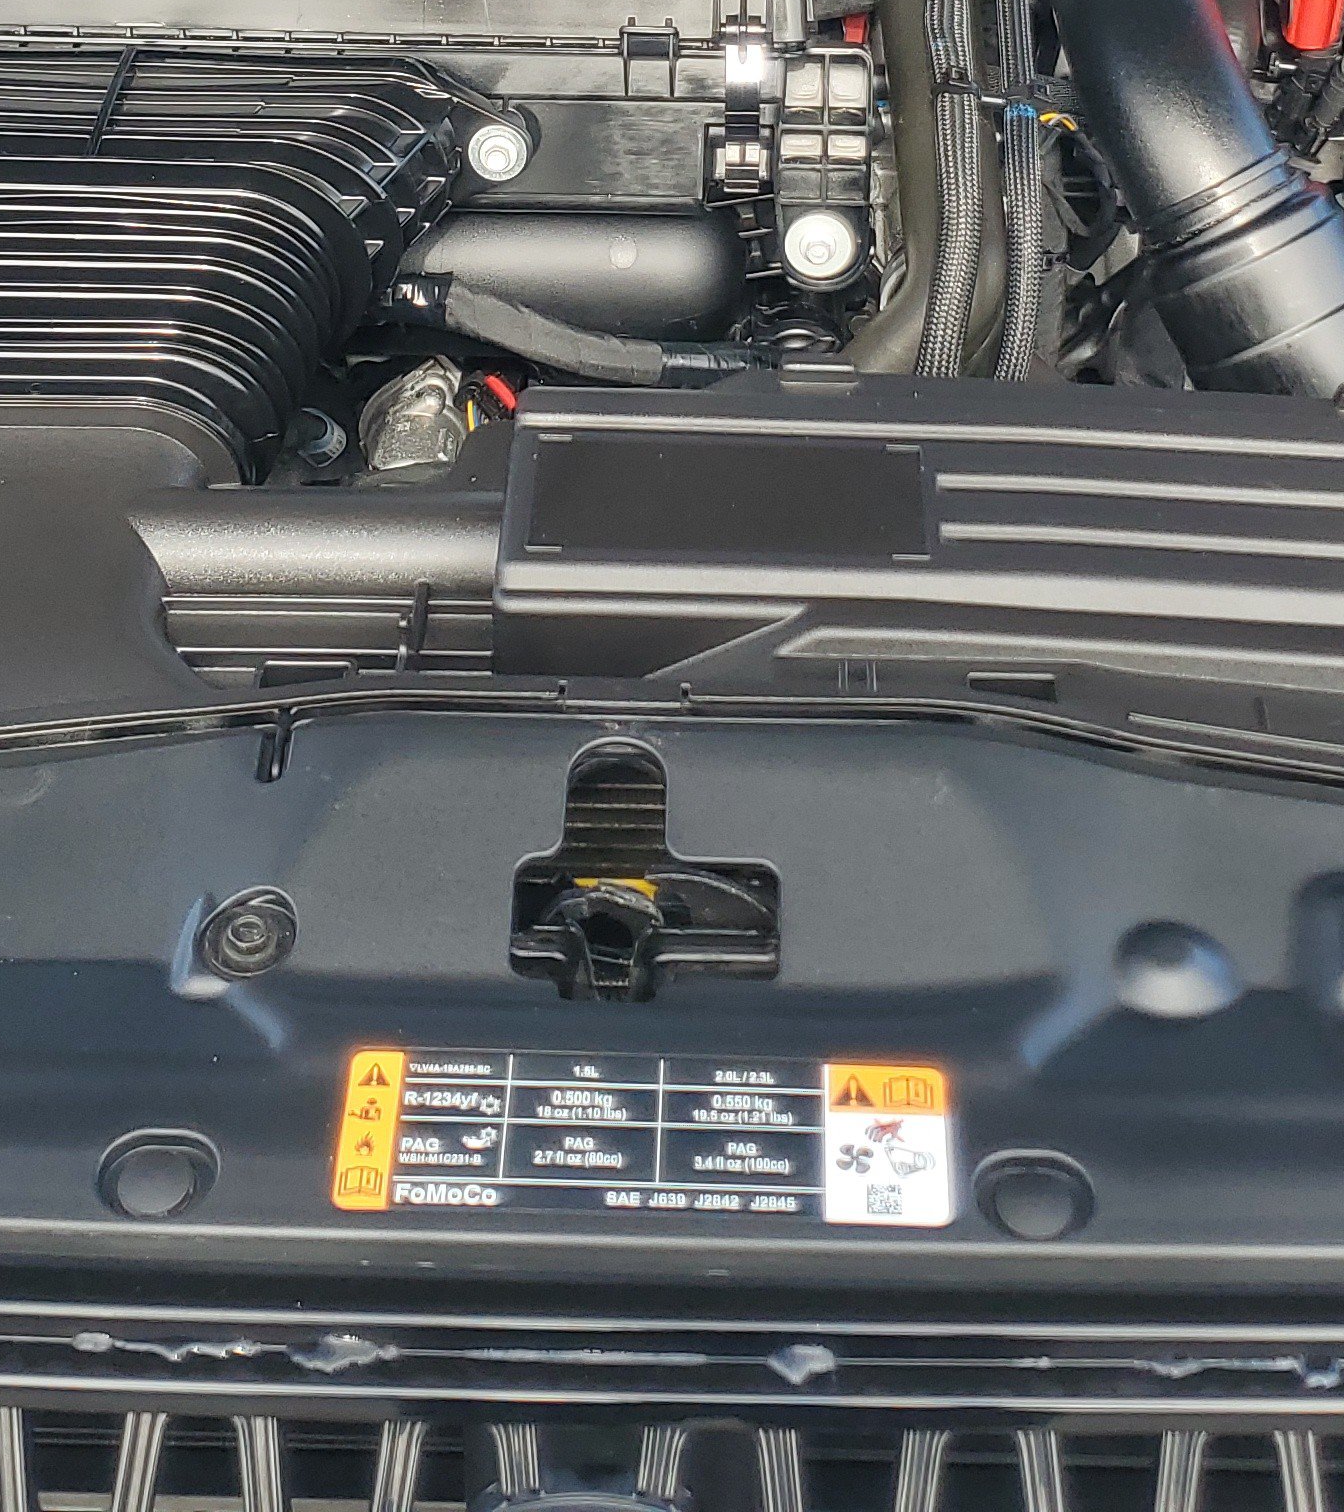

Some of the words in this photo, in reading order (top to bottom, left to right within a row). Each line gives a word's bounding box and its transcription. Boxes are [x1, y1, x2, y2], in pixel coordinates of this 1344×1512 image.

[573, 1066, 600, 1078] 1.5L
[715, 1071, 741, 1083] 2.0L
[404, 1091, 479, 1110] R-1234yf
[552, 1090, 591, 1104] 0.500
[594, 1091, 613, 1107] kg
[713, 1095, 751, 1109] 0.550
[754, 1096, 773, 1113] kg
[537, 1105, 552, 1117] 18
[554, 1108, 570, 1118] oz
[572, 1106, 600, 1120] (1.10
[603, 1108, 627, 1121] lbs)
[720, 1112, 736, 1122] oz
[738, 1111, 766, 1124] (1.21
[770, 1111, 793, 1125] lbs)
[401, 1137, 440, 1152] PAG
[565, 1137, 595, 1150] PAG
[727, 1143, 757, 1155] PAG
[534, 1150, 553, 1164] 2.7
[555, 1150, 564, 1164] fl
[567, 1154, 582, 1163] oz
[585, 1152, 623, 1169] (80cc)
[716, 1156, 724, 1169] fl
[727, 1159, 742, 1169] oz
[745, 1157, 789, 1175] (100cc)
[394, 1183, 498, 1204] FoMoCo
[606, 1192, 640, 1206] SAE
